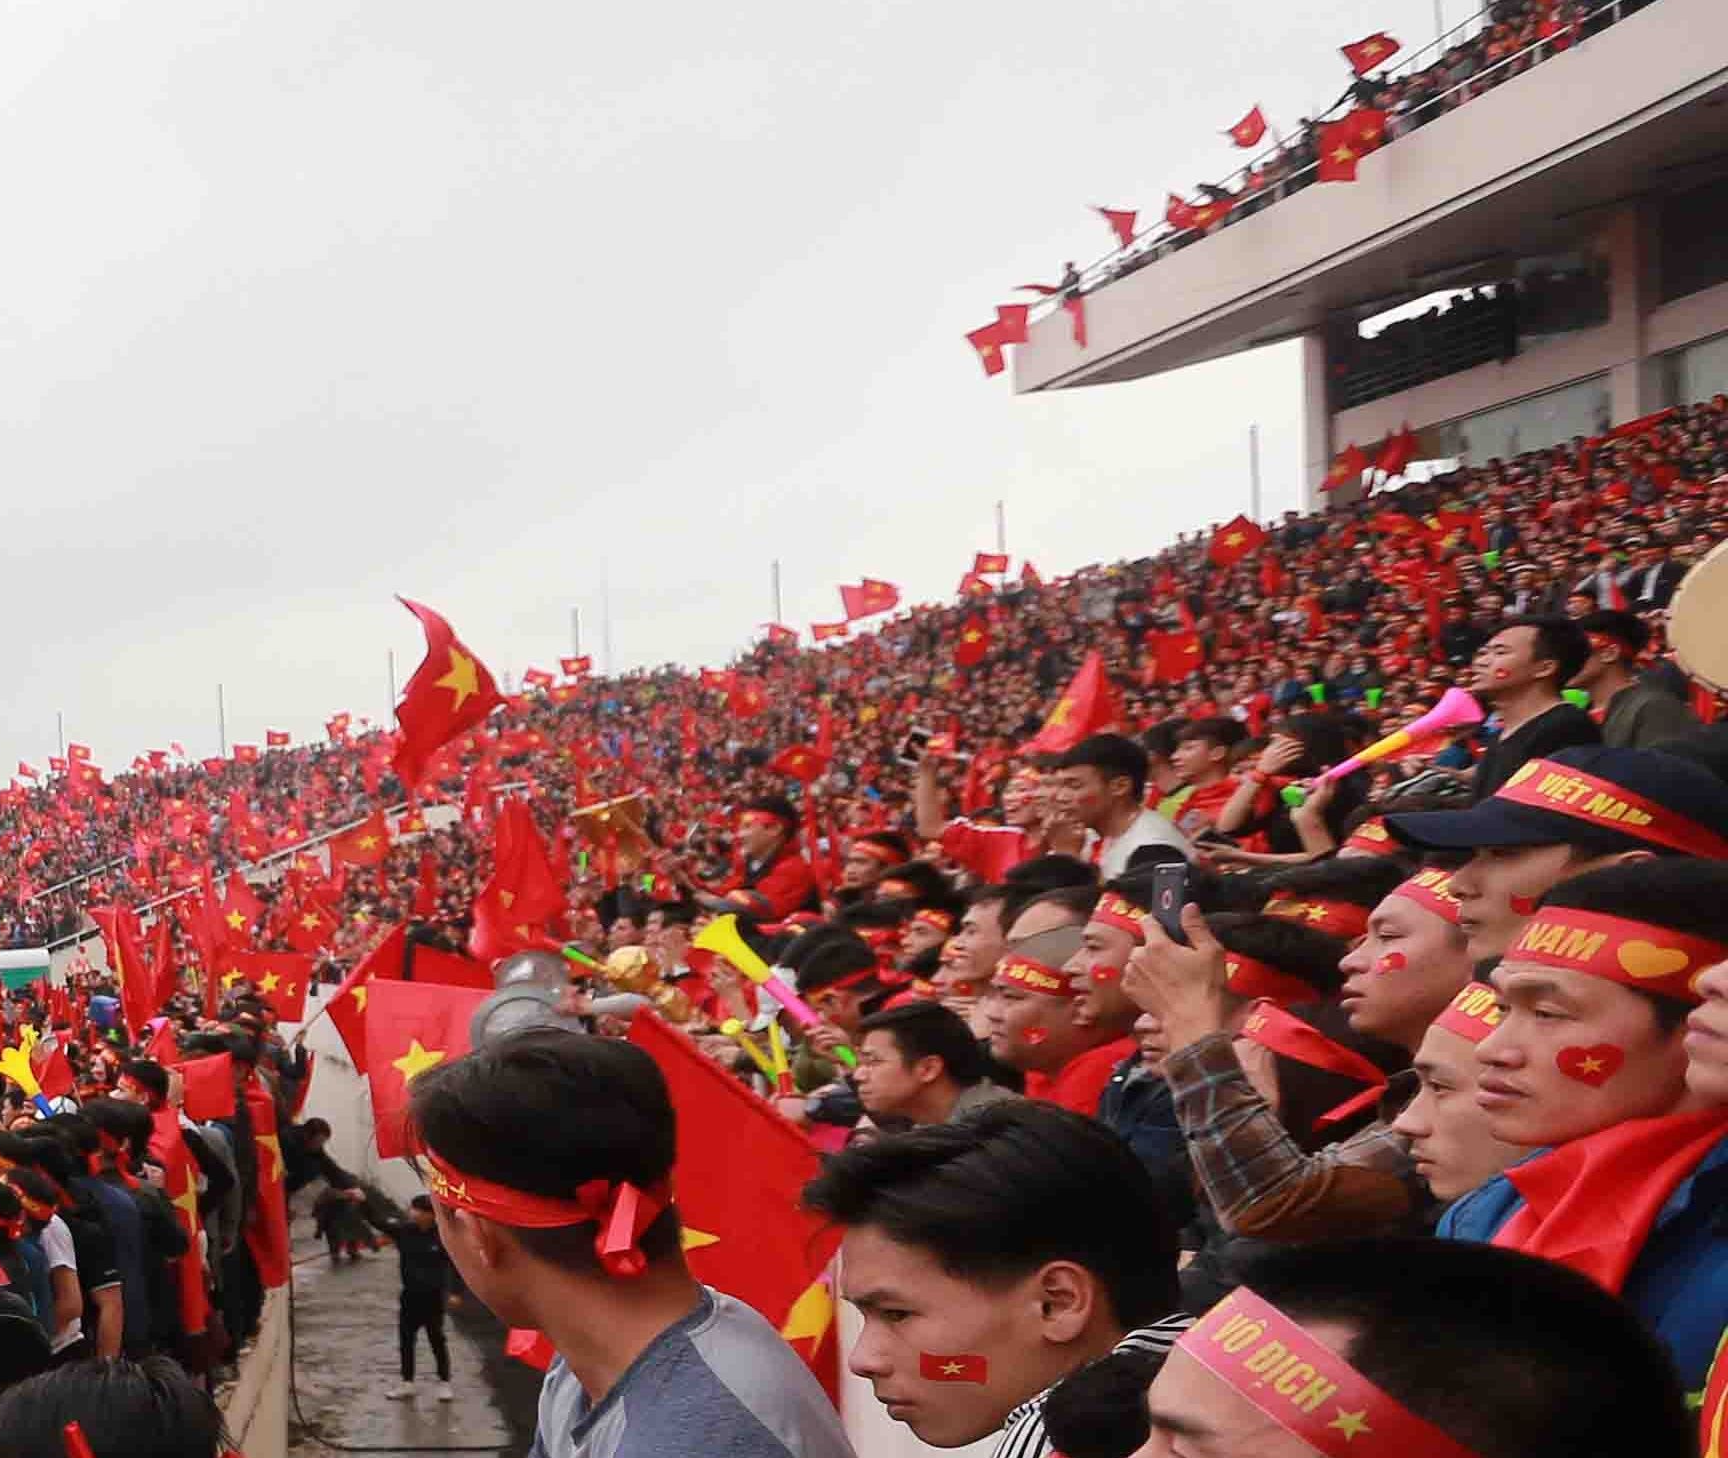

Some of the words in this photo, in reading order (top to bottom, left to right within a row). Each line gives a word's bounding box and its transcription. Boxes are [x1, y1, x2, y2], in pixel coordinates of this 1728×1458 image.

[1536, 771, 1592, 804] VIỆT
[1580, 793, 1653, 825] NAM
[1516, 923, 1608, 962] NAM
[1210, 1312, 1267, 1354] VÔ
[1245, 1339, 1337, 1413] ĐỊCH
